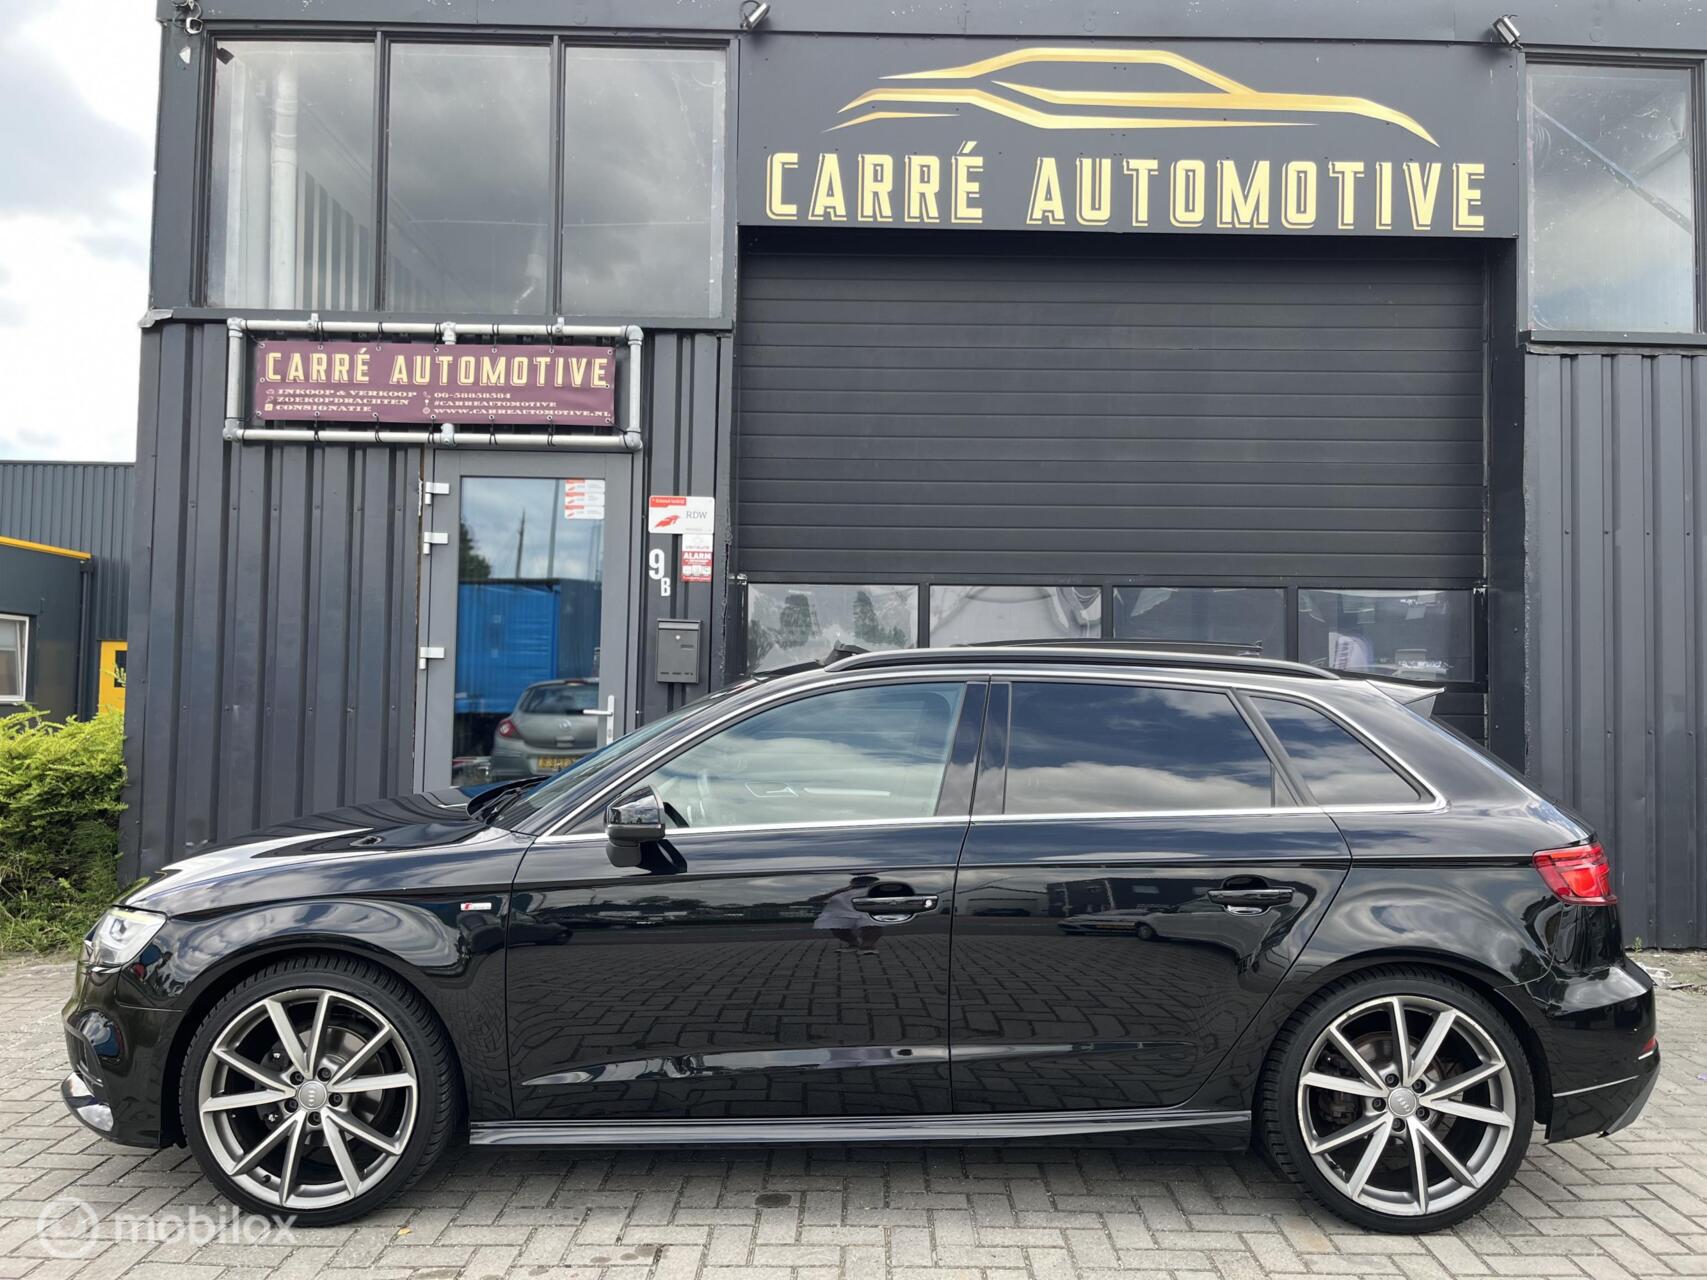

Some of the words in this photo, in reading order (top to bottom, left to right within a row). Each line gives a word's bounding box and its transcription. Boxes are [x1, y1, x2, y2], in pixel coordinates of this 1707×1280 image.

[765, 140, 985, 226] CARRÉ
[1026, 155, 1487, 232] AUTOMOTIVE
[265, 347, 370, 384] CARRÉ
[389, 355, 608, 388] AUTOMOTIVE
[278, 388, 334, 396] INKOOP
[349, 390, 417, 398] VERKOOP
[276, 396, 410, 405] ZOEKOPDRACHTEN
[276, 404, 372, 412] CONSIGNATIE
[686, 511, 708, 519] RDW
[683, 552, 711, 560] ALARM
[649, 548, 665, 580] 9
[660, 577, 671, 597] B
